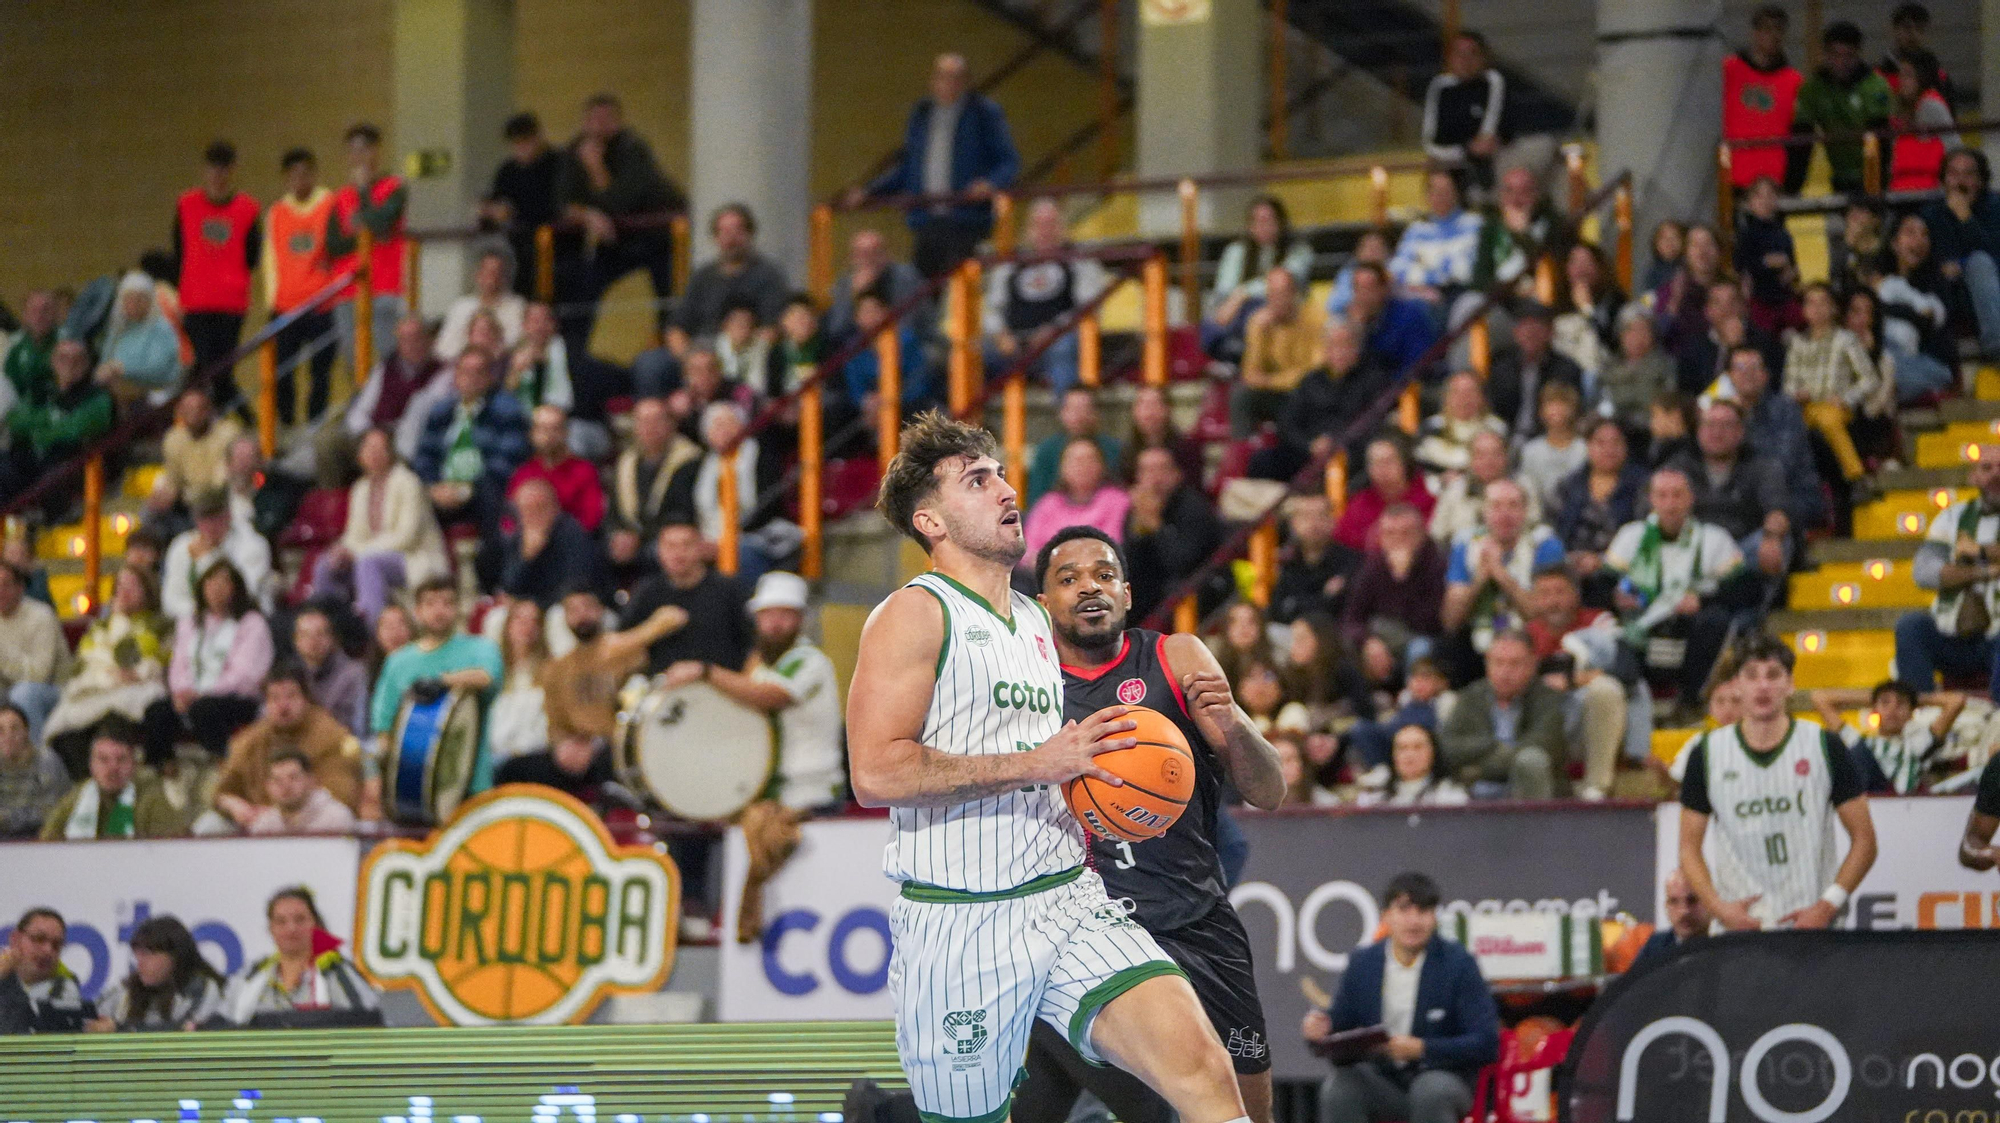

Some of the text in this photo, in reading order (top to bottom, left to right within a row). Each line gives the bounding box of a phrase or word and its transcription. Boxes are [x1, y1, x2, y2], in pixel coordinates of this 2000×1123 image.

[993, 680, 1051, 715] coto
[1735, 797, 1791, 818] coto
[1765, 833, 1789, 866] 10
[379, 871, 651, 966] CORDOBA
[1616, 1015, 1849, 1123] no
